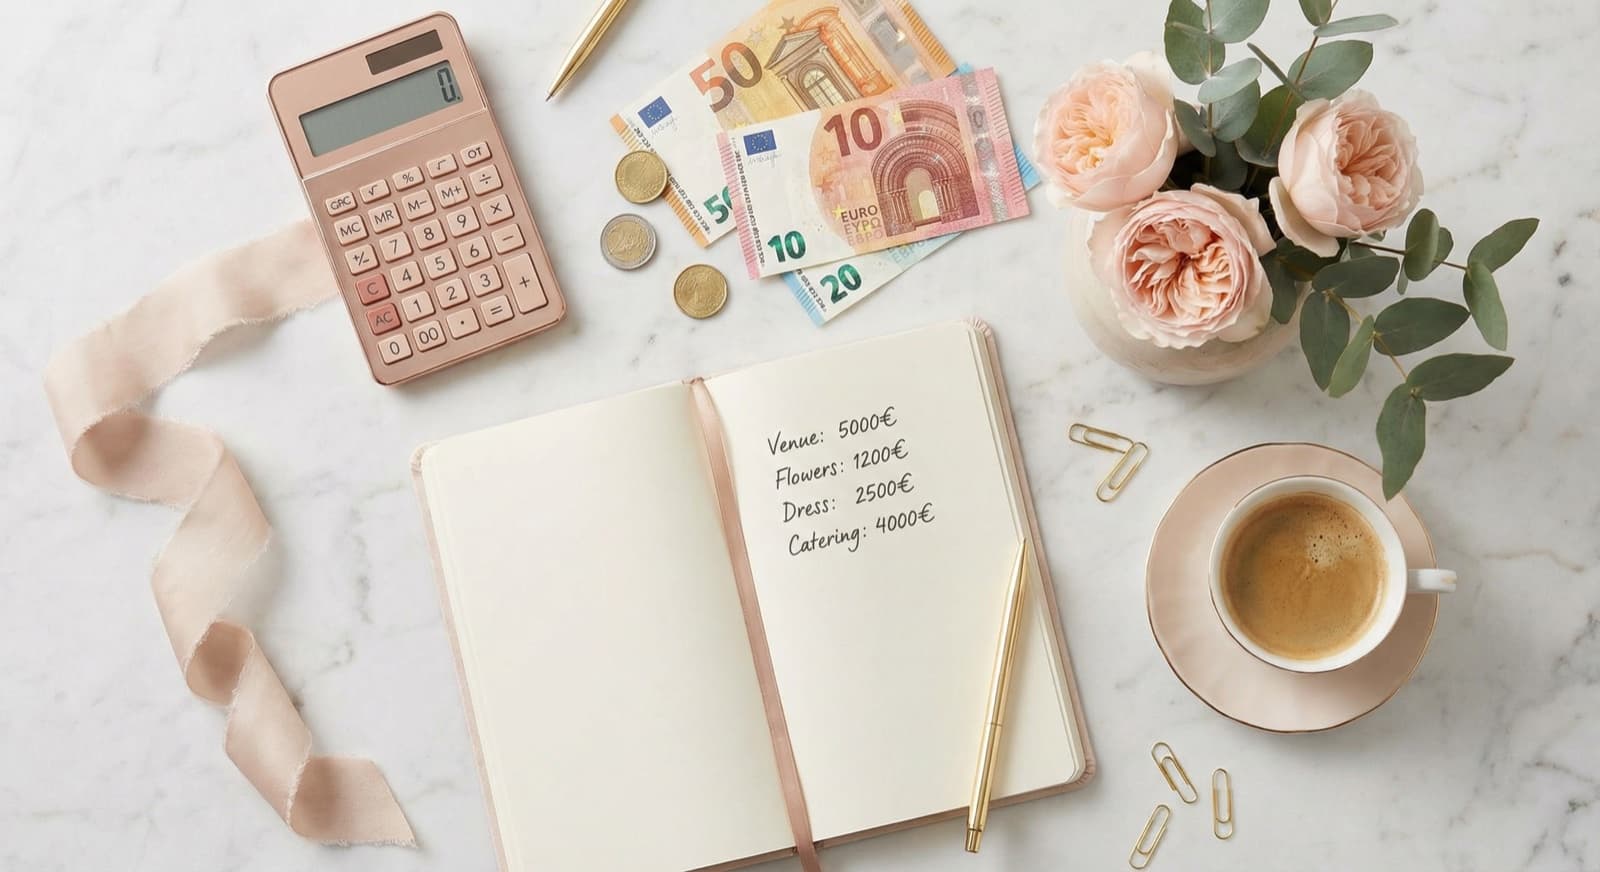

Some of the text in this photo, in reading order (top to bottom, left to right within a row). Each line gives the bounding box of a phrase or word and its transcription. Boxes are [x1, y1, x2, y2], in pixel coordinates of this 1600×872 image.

[689, 41, 763, 113] 50
[823, 107, 883, 158] 10
[467, 147, 482, 159] OT
[441, 185, 462, 200] M+
[374, 210, 395, 225] MR
[840, 204, 878, 223] EURO
[456, 214, 468, 229] 9
[340, 222, 362, 237] MC
[423, 227, 435, 241] 8
[388, 240, 398, 255] 7
[470, 244, 480, 258] 6
[767, 230, 806, 263] 10
[435, 257, 446, 272] 5
[402, 268, 413, 282] 4
[480, 273, 491, 288] 3
[366, 282, 380, 296] C
[819, 263, 862, 305] 20
[446, 286, 458, 301] 2
[413, 299, 422, 313] 1
[375, 311, 393, 326] AC
[419, 328, 440, 344] 00
[389, 341, 401, 355] 0
[767, 406, 897, 456] Venue: 5000€
[776, 438, 909, 490] Flowers: 1200€
[783, 472, 915, 523] Dress: 2500€
[789, 502, 935, 556] Catering: 4000€
